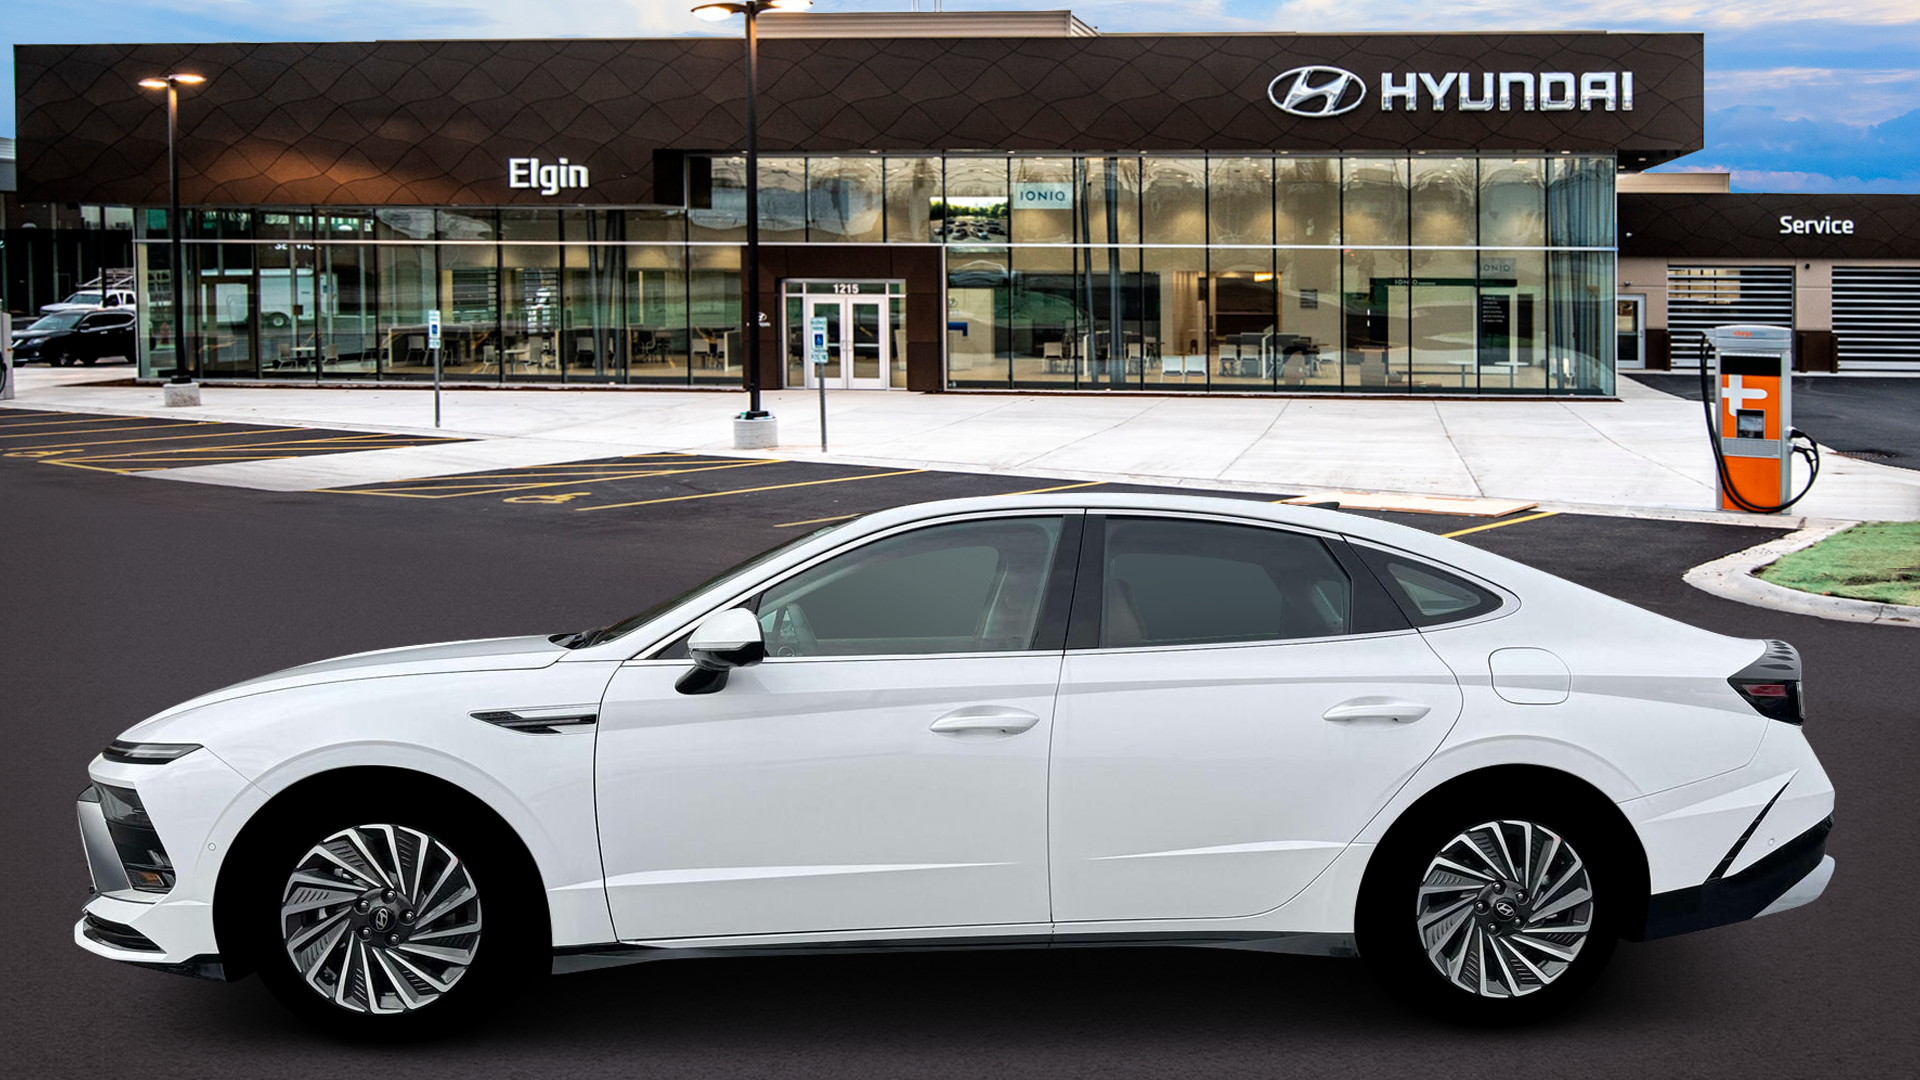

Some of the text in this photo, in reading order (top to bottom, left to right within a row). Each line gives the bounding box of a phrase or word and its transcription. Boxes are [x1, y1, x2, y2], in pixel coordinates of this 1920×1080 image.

[1380, 71, 1634, 112] HYUNDAI
[508, 157, 590, 196] Elgin
[1020, 190, 1067, 202] IONIQ
[1779, 215, 1855, 235] Service
[1479, 264, 1511, 272] ONIQ
[832, 283, 860, 294] 1215
